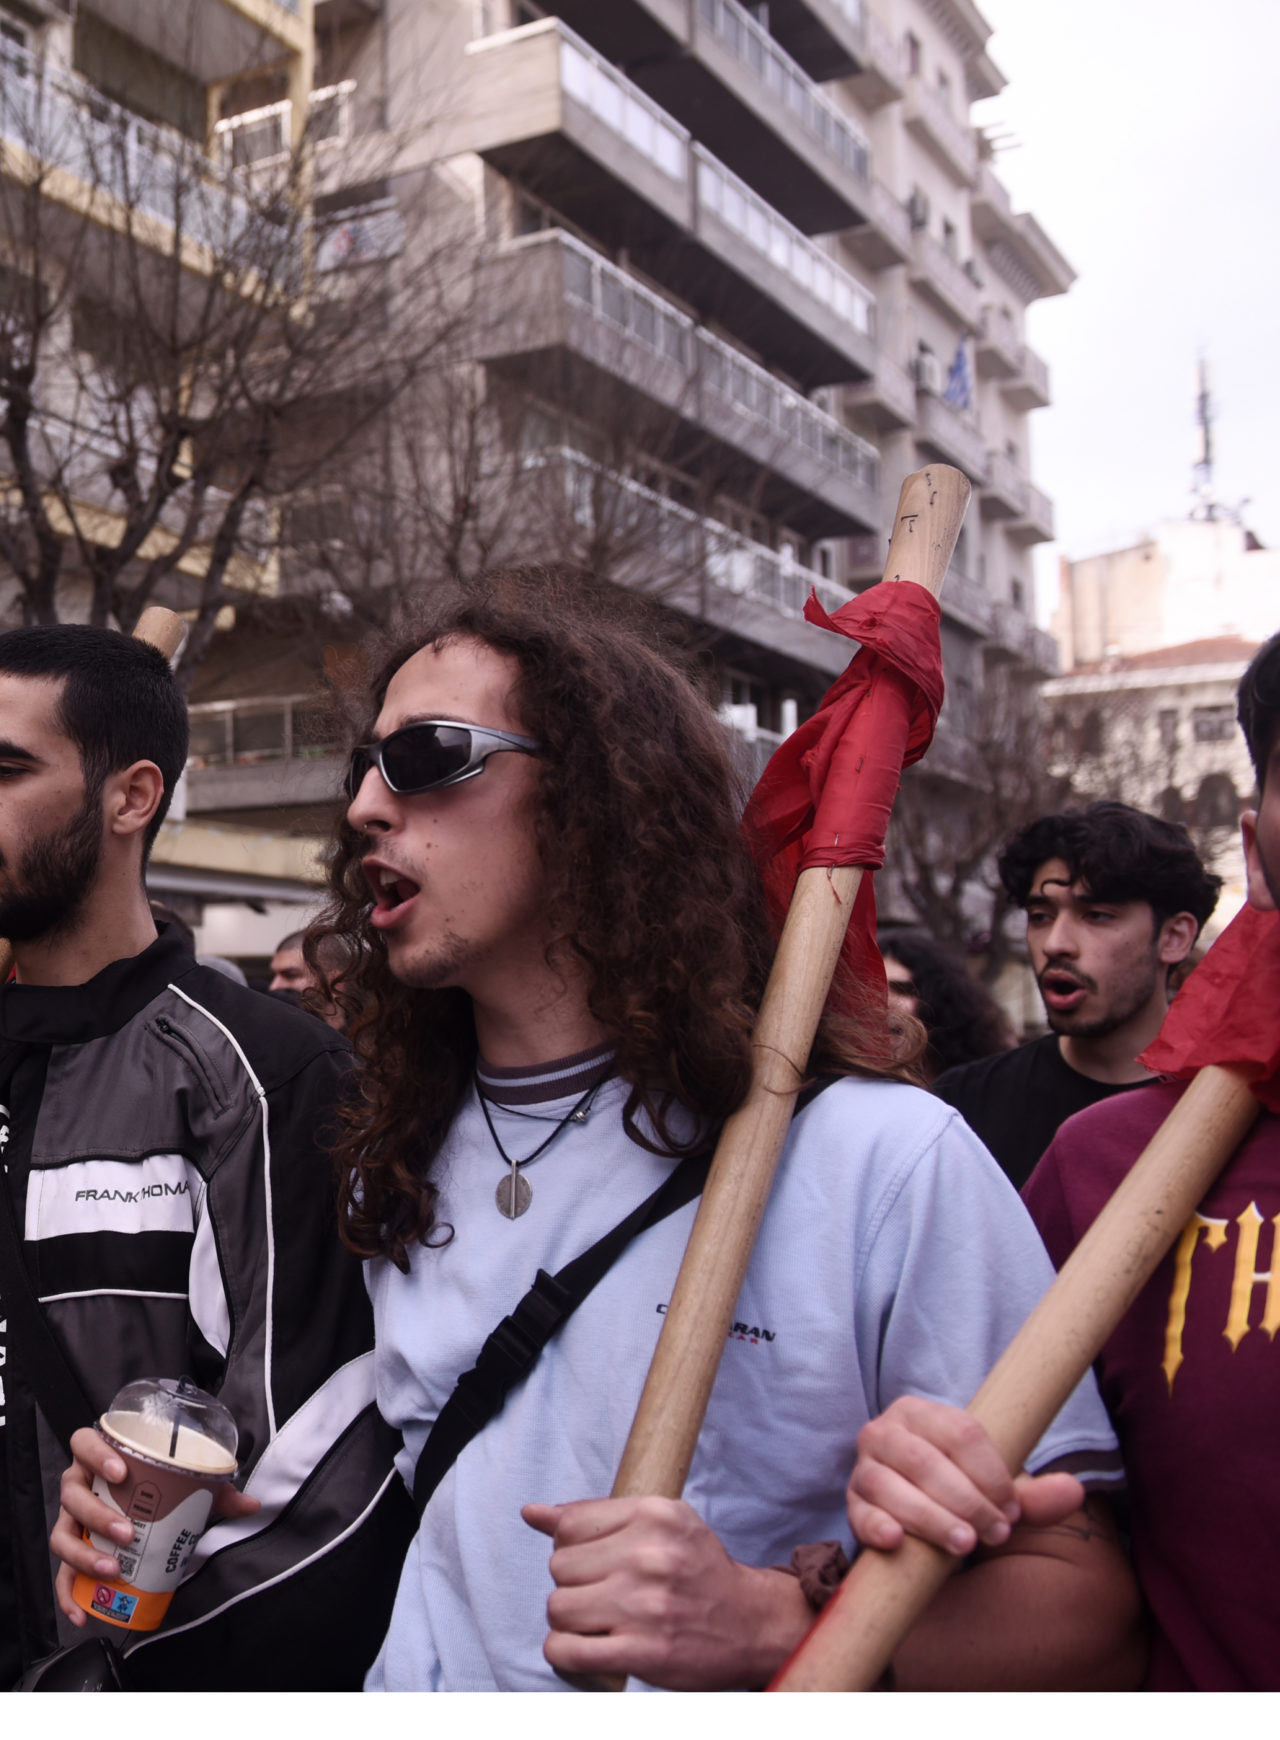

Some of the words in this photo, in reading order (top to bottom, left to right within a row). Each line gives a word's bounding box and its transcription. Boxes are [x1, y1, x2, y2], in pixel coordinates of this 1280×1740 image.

[75, 1189, 140, 1203] FRANK
[141, 1181, 190, 1200] HOMA
[165, 1529, 192, 1573] COFFEE
